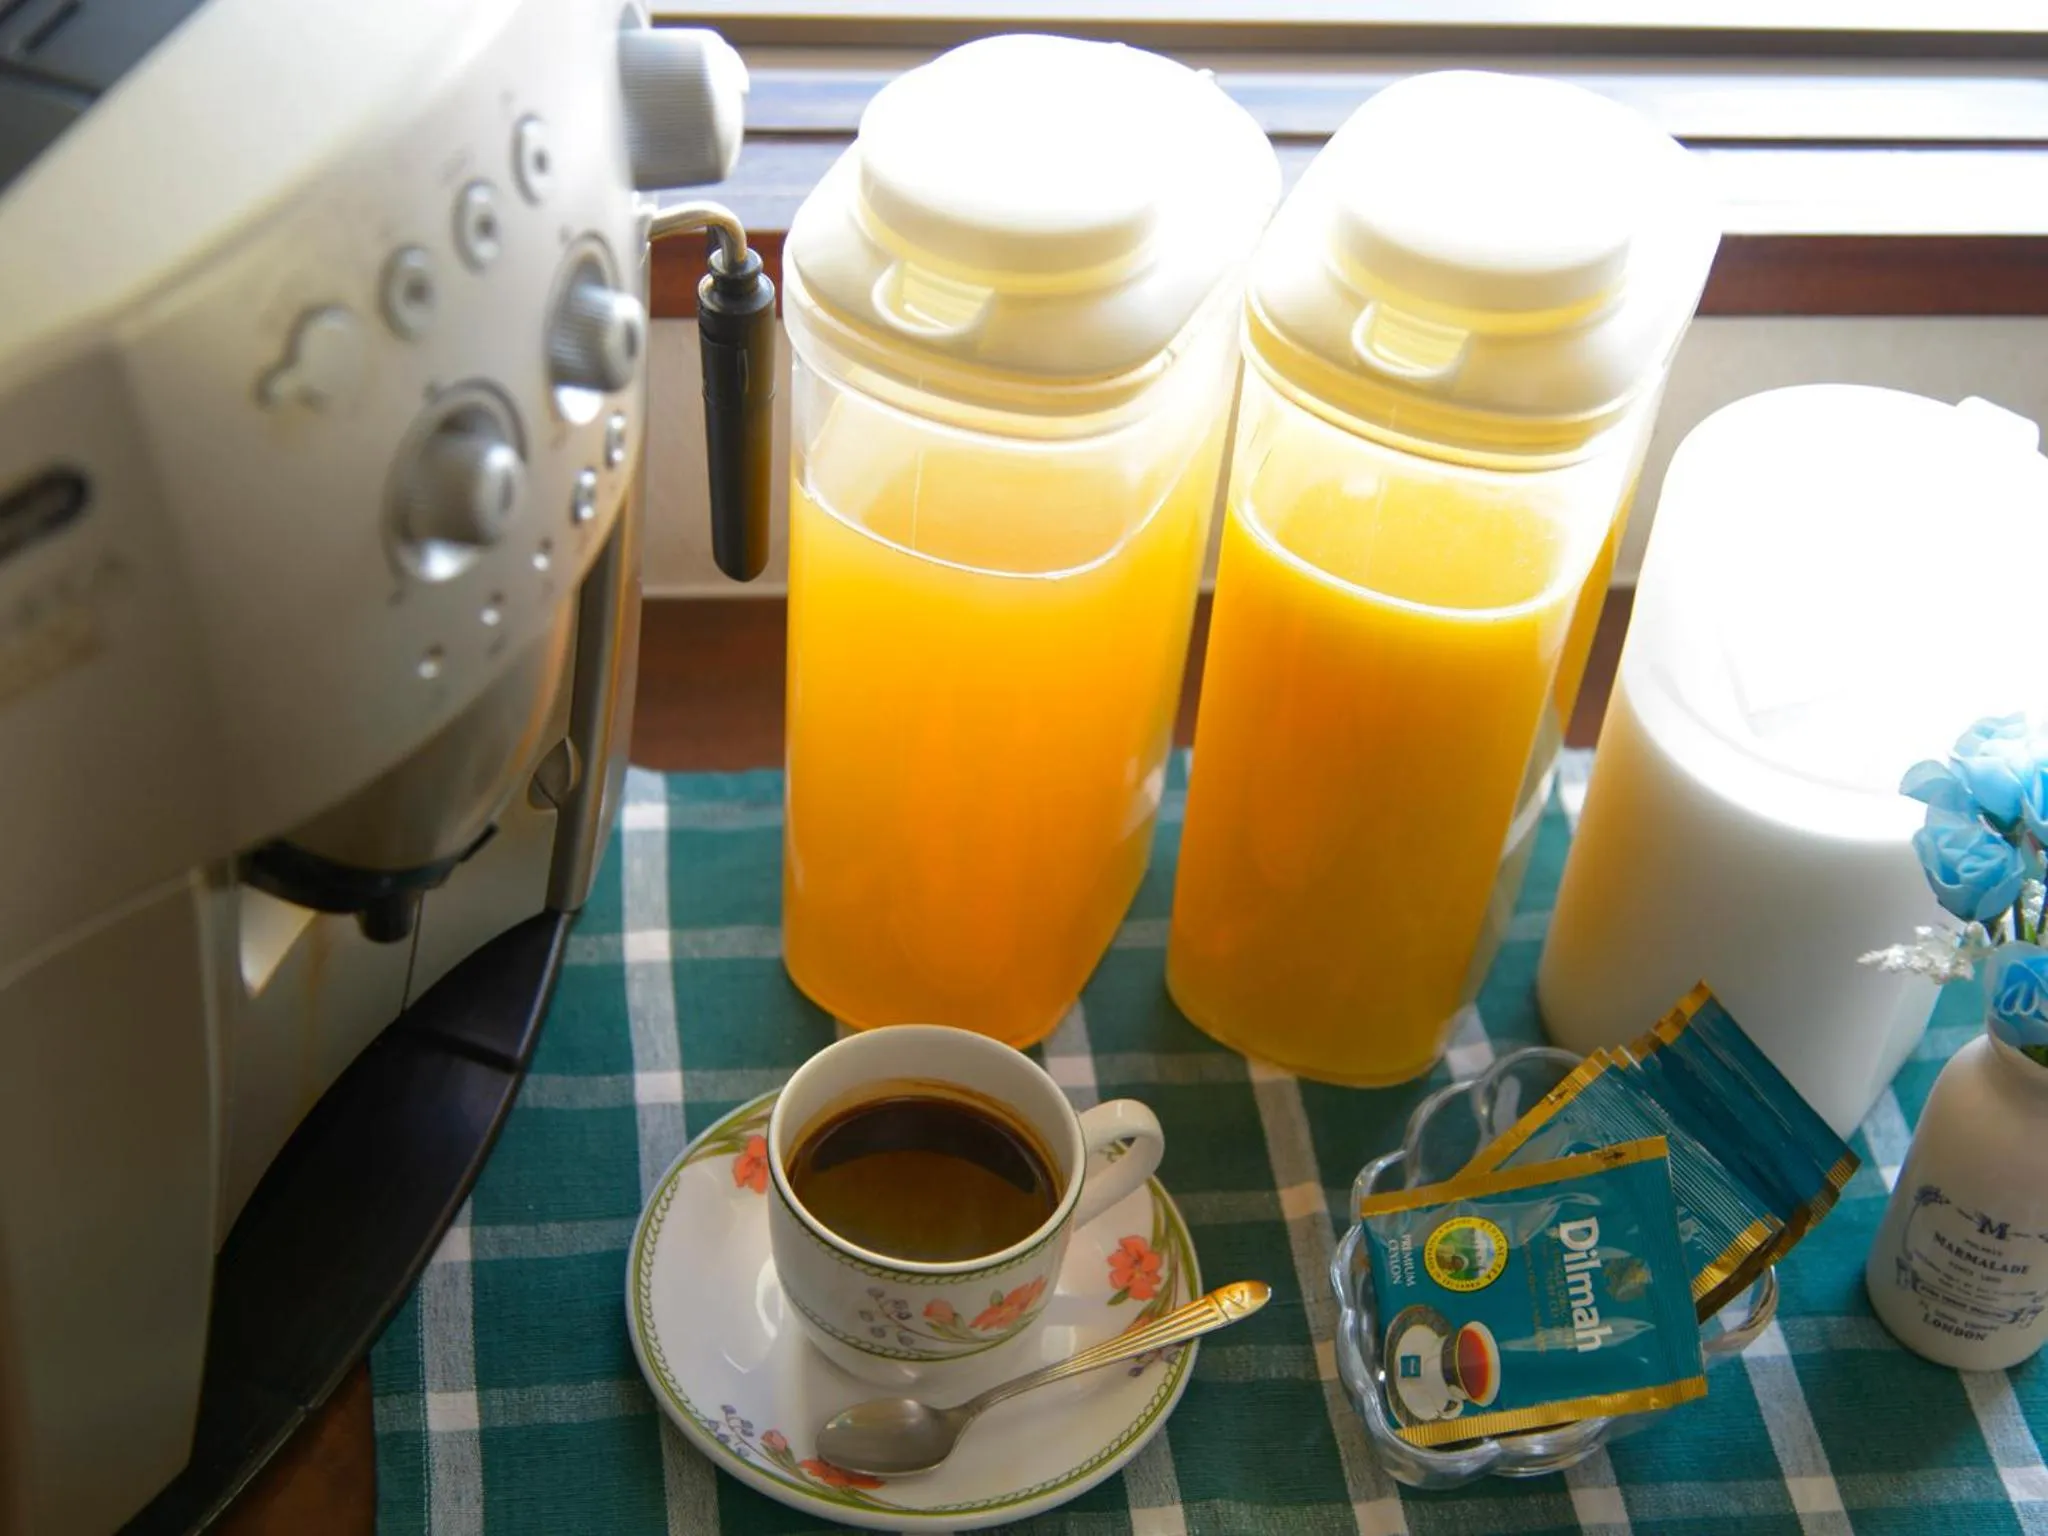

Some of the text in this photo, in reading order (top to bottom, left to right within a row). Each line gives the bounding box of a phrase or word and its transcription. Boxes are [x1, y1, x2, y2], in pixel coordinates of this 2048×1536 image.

[1976, 1212, 2011, 1241] M
[1387, 1239, 1402, 1285] CEYLON
[1401, 1234, 1417, 1287] PREMIUM
[1933, 1230, 2030, 1275] MARMALADE
[1559, 1217, 1613, 1352] Dilmah
[1923, 1312, 1988, 1342] LONDON
